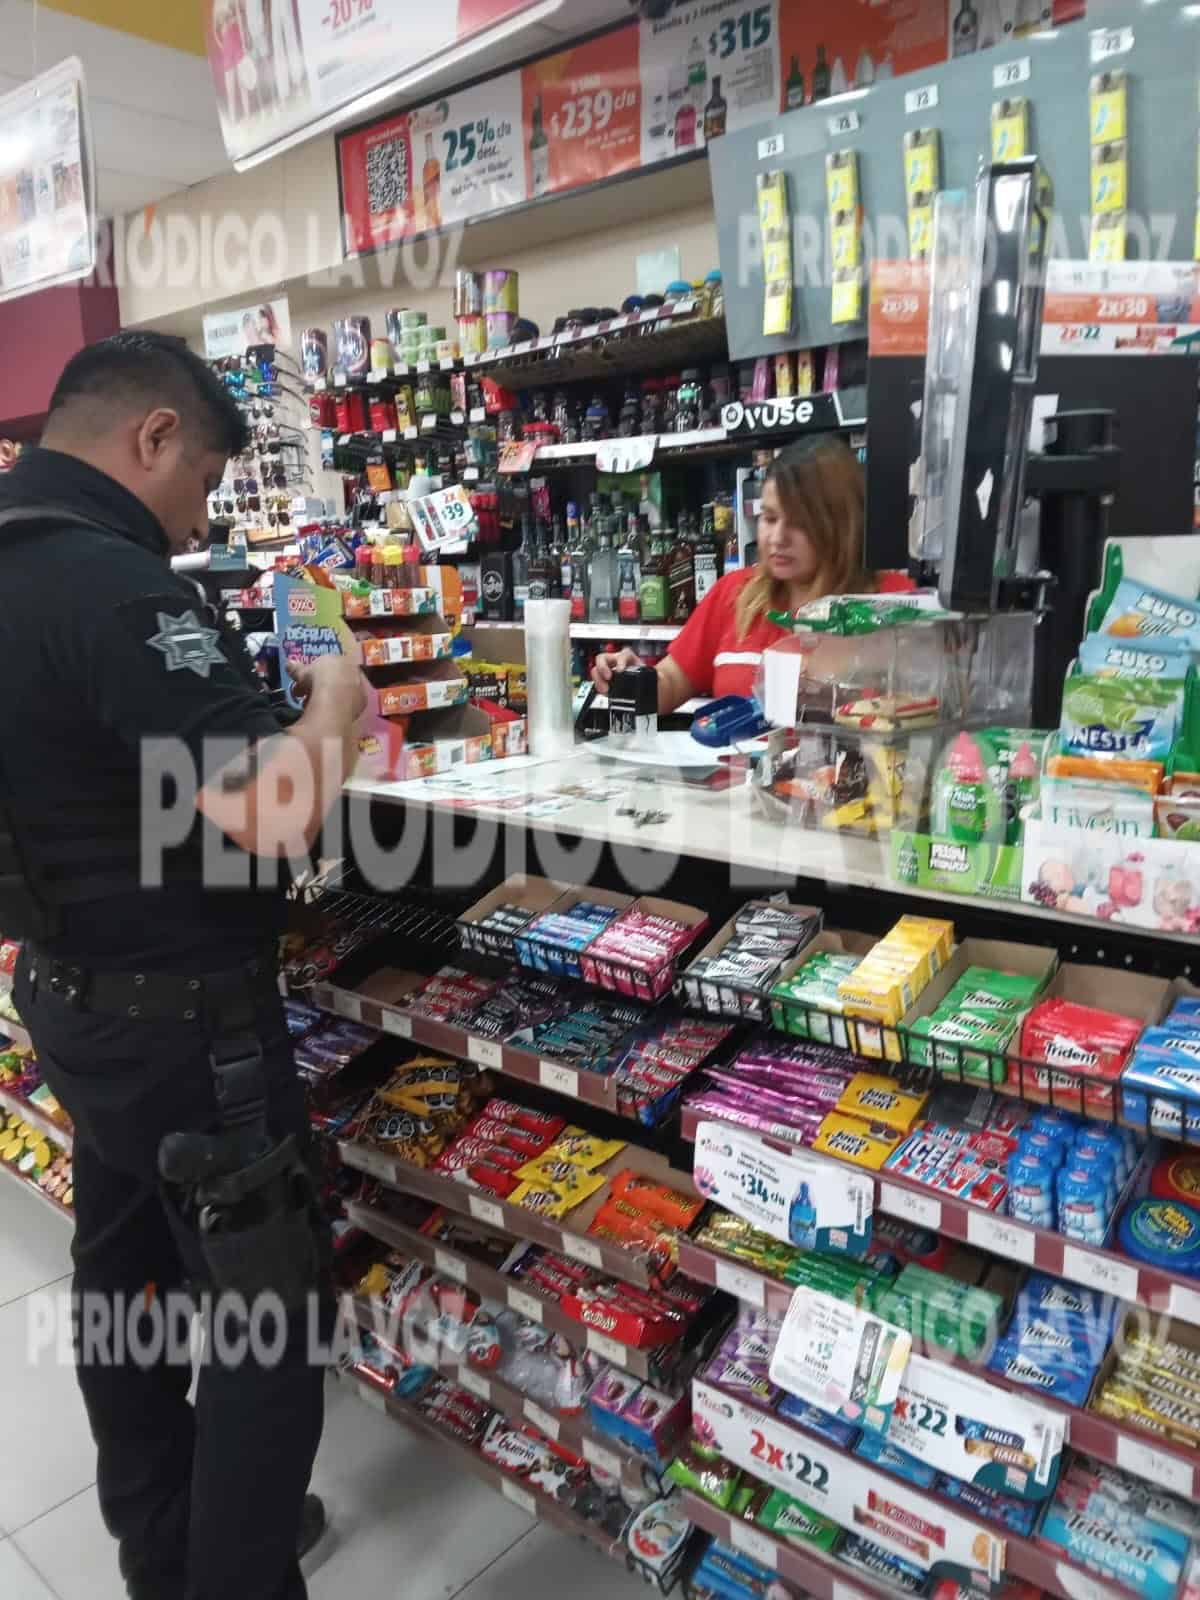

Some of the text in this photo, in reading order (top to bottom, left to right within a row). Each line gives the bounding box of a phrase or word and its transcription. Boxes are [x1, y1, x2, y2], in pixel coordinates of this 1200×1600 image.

[708, 5, 772, 59] $315
[551, 90, 613, 140] $239
[443, 117, 496, 172] 25%
[744, 399, 814, 429] vuse
[1137, 594, 1196, 627] ZUKO
[1105, 648, 1167, 670] ZUKO
[1069, 725, 1150, 751] NESTEA
[1045, 1041, 1099, 1066] Trident
[1040, 1286, 1090, 1314] Trident
[1024, 1324, 1074, 1349] Trident
[1006, 1357, 1057, 1388] Trident
[984, 1429, 1014, 1445] HALLS
[777, 1505, 822, 1537] Trident
[1067, 1513, 1154, 1562] Trident
